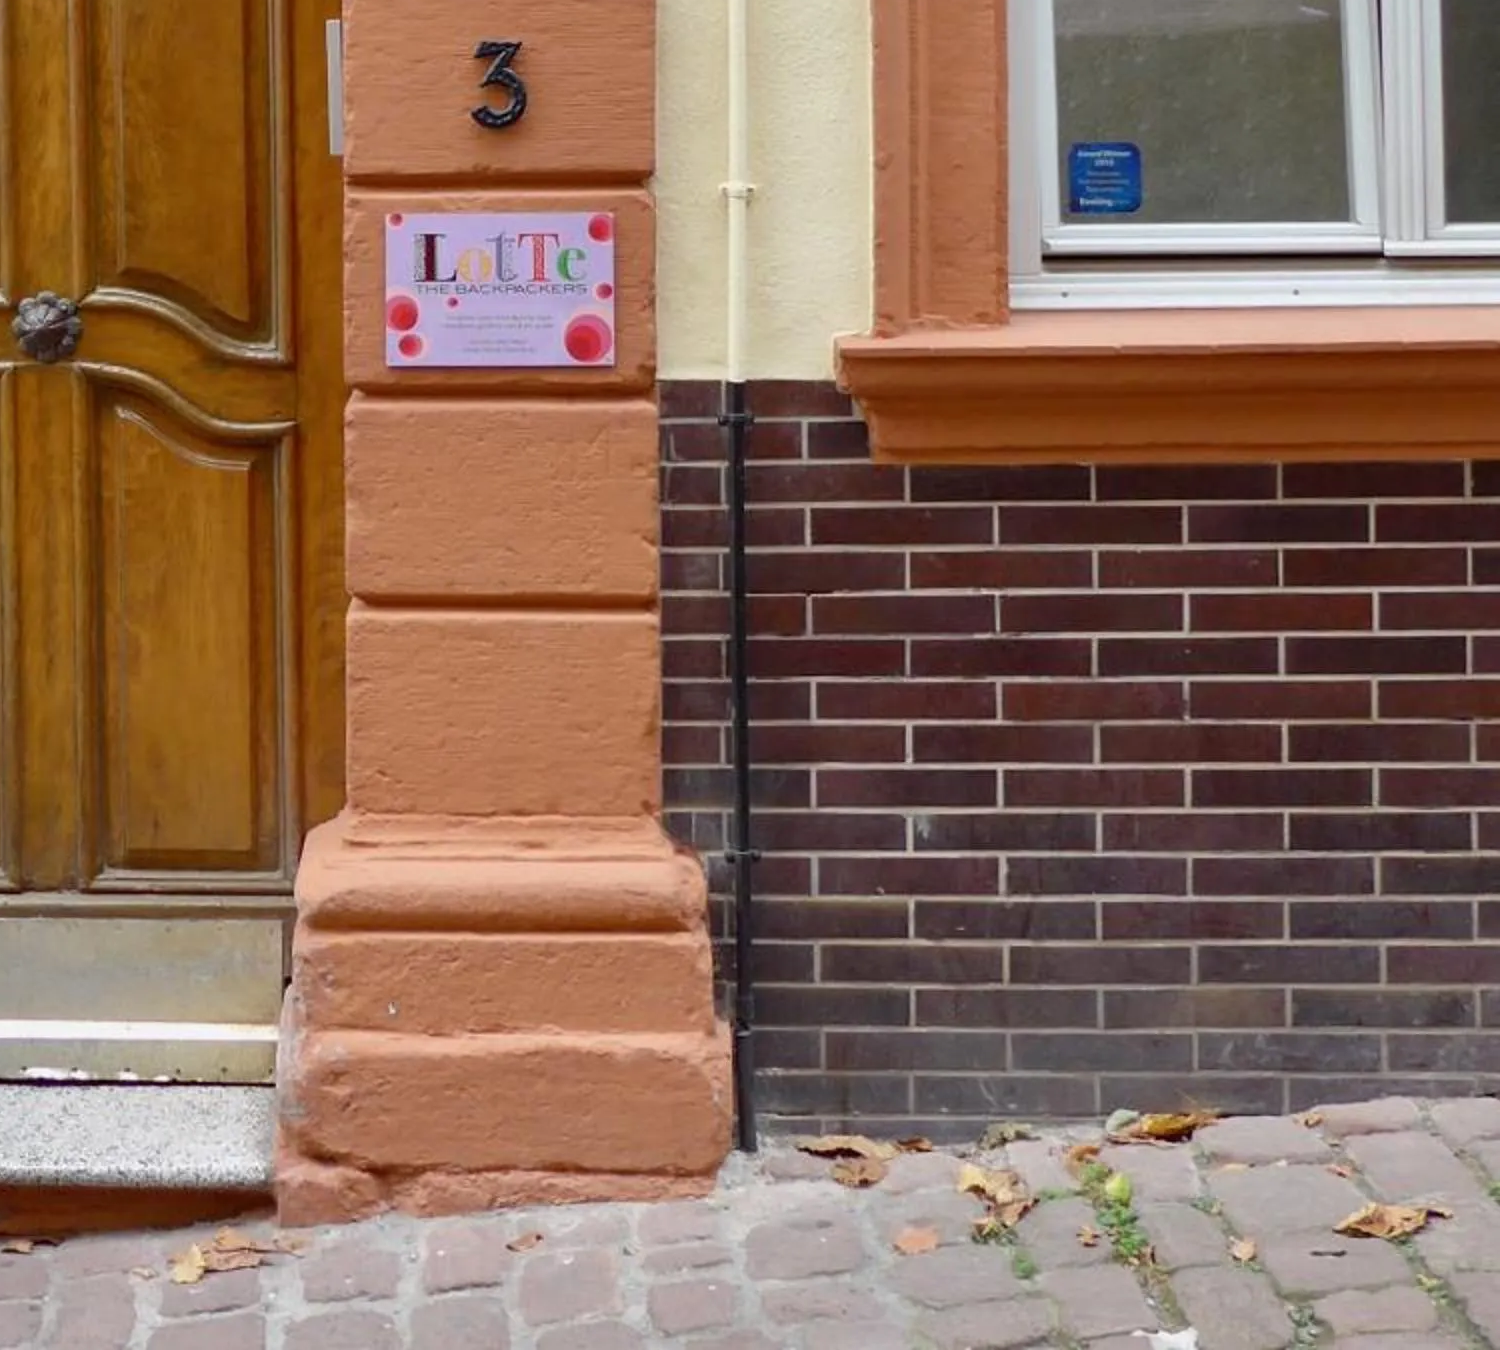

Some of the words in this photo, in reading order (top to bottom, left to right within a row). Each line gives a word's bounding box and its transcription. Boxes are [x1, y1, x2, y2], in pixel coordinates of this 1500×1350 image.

[471, 41, 528, 128] 3
[416, 284, 449, 295] THE
[455, 284, 588, 295] BACKPACKERS
